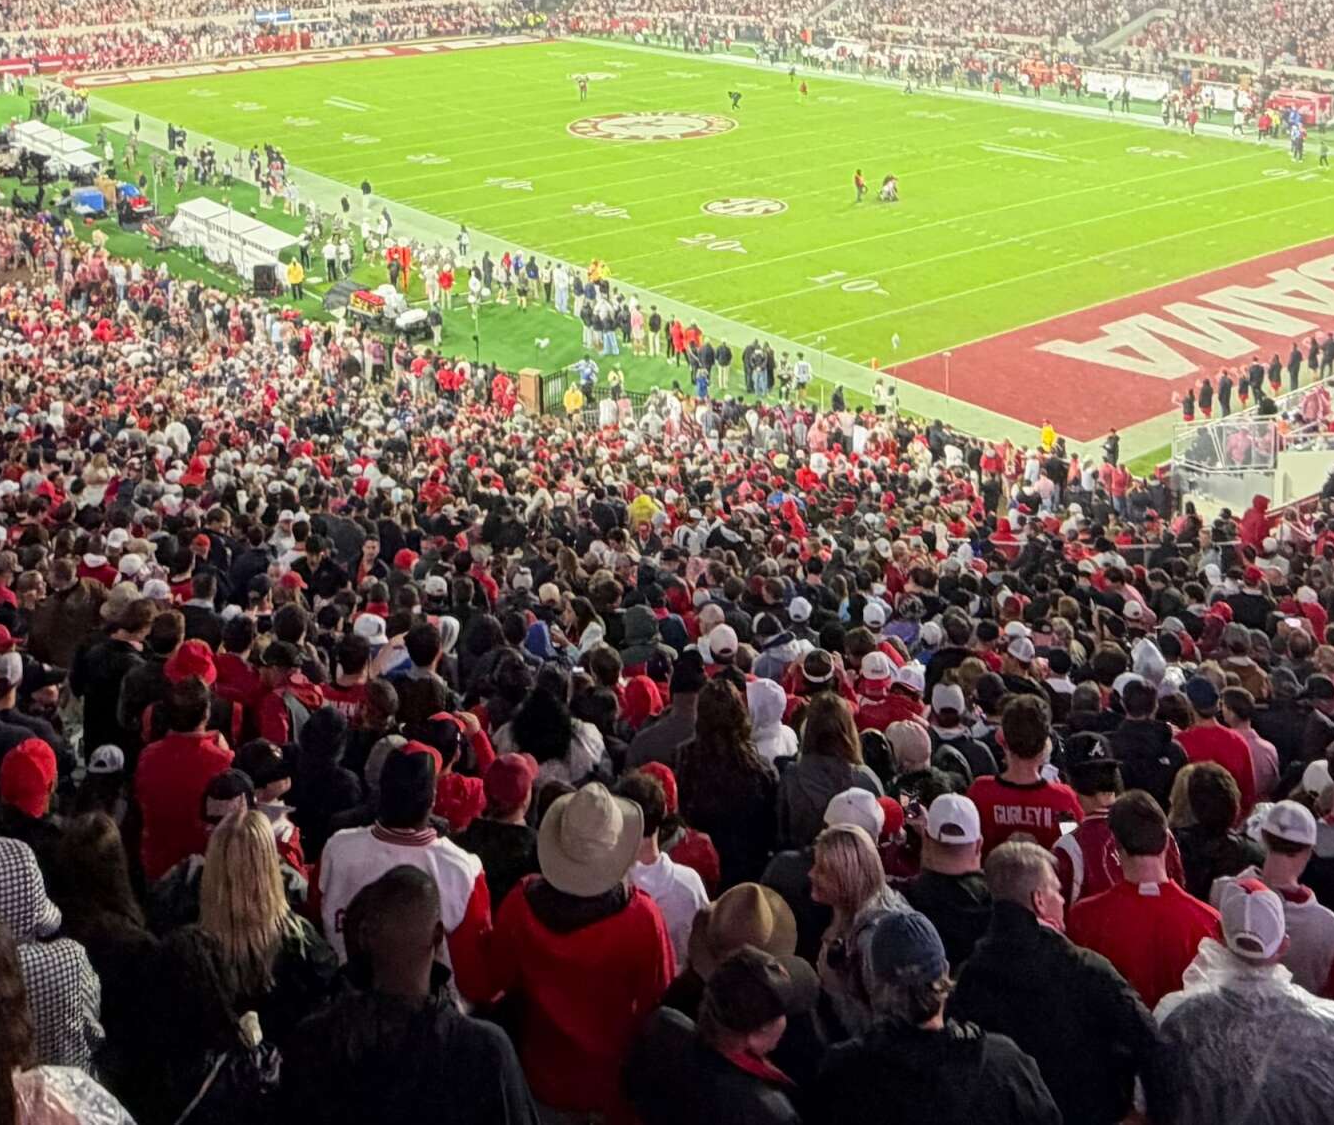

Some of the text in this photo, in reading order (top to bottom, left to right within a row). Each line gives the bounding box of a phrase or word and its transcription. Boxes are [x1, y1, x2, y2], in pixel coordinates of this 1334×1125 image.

[73, 47, 395, 85] CRIMSON
[806, 269, 880, 292] 10
[993, 804, 1042, 827] GURLEY
